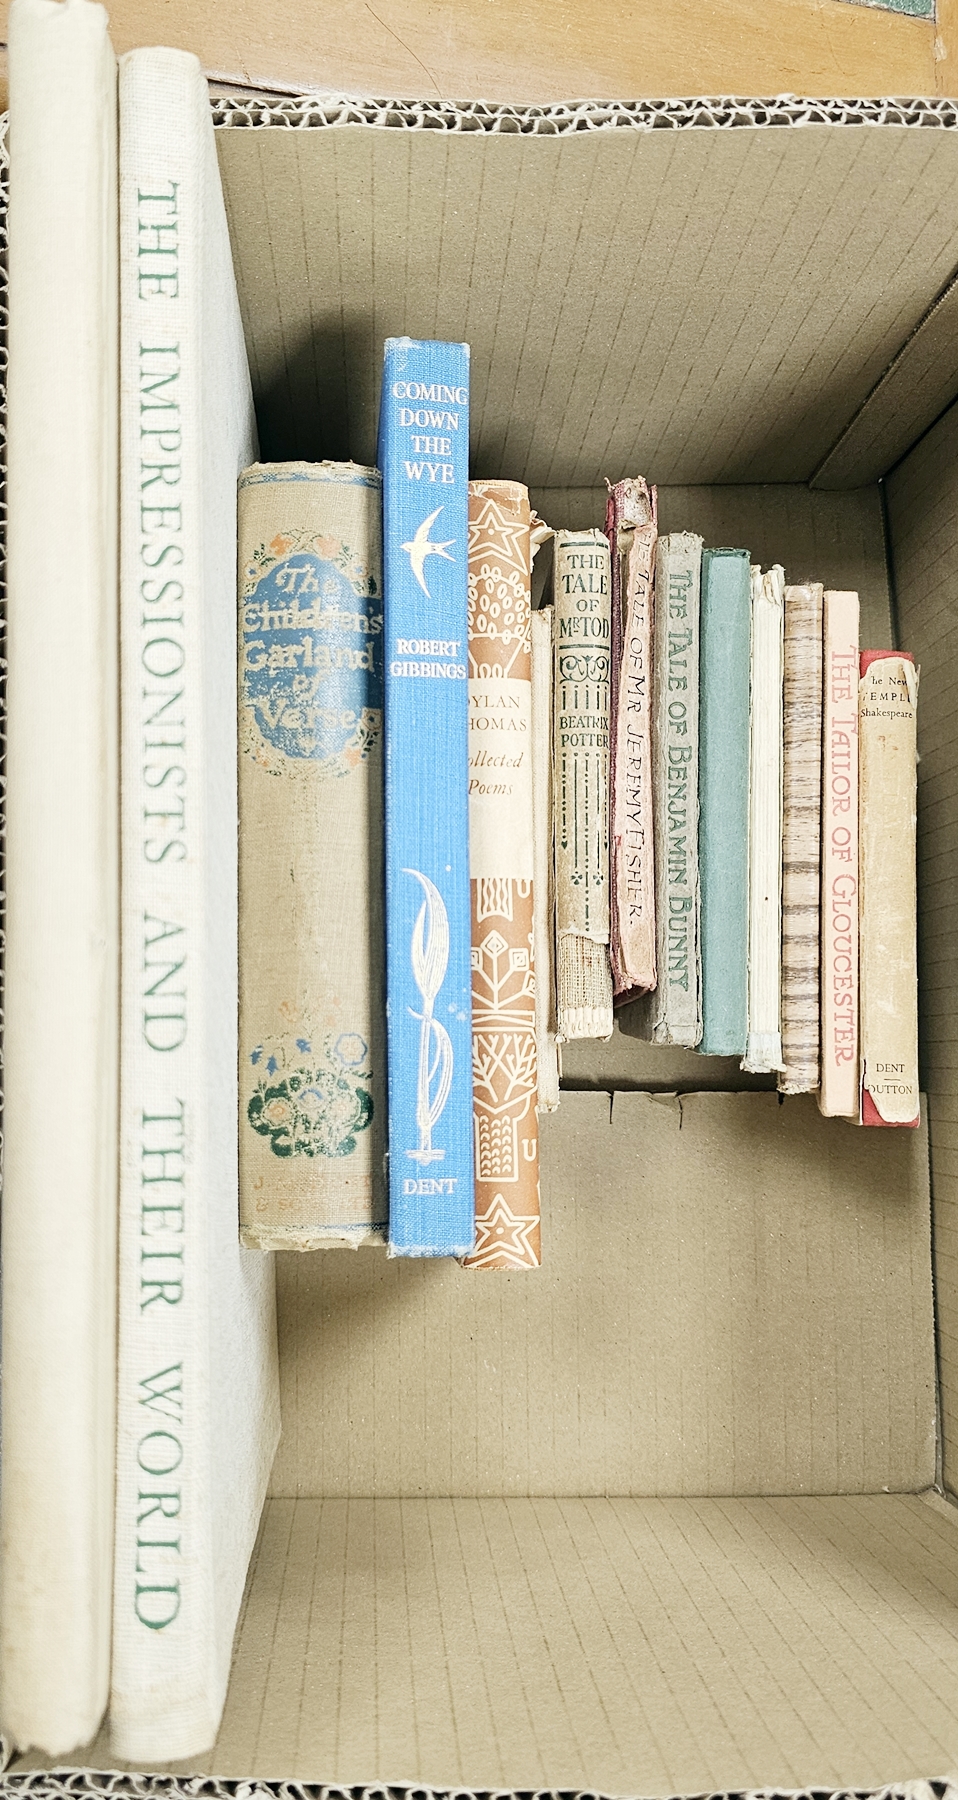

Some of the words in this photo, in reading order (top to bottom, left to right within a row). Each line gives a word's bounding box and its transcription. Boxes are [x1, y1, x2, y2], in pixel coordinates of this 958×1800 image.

[137, 179, 180, 301] THE
[392, 381, 469, 405] COMING
[399, 407, 459, 430] DOWN
[410, 435, 452, 456] THE
[402, 461, 455, 484] WYE
[568, 554, 604, 569] THE
[276, 564, 339, 594] The
[562, 573, 608, 595] TALE
[138, 341, 187, 864] IMPRESSIONISTS
[576, 599, 600, 612] OF
[632, 569, 650, 627] TALE
[668, 569, 694, 620] THE
[239, 598, 384, 636] Children's
[579, 616, 610, 639] TOD
[243, 636, 375, 675] Garland
[397, 638, 460, 657] ROBERT
[629, 637, 644, 670] OF
[668, 628, 694, 692] TALE
[390, 662, 466, 679] GIBBINGS
[831, 644, 858, 704] THE
[871, 675, 883, 685] he
[889, 676, 908, 686] New
[293, 669, 326, 700] of
[626, 675, 646, 714] MR
[863, 691, 911, 703] EMPL
[469, 695, 521, 709] YLAN
[861, 707, 913, 720] Shakespeare
[469, 717, 527, 732] HOMAS
[559, 715, 609, 730] BEATRIX
[668, 701, 688, 736] OF
[561, 733, 610, 750] POTTER
[468, 750, 524, 768] ollected
[831, 711, 858, 817] TAILOR
[468, 779, 513, 795] Poems
[667, 745, 693, 886] BENJAMIN
[831, 826, 853, 863] OF
[668, 896, 693, 992] BUNNY
[142, 909, 187, 1052] AND
[831, 872, 857, 1066] GLOUCESTER
[876, 1063, 906, 1073] DENT
[403, 1178, 458, 1195] DENT
[140, 1096, 184, 1316] THEIR
[134, 1361, 183, 1630] WORLD
